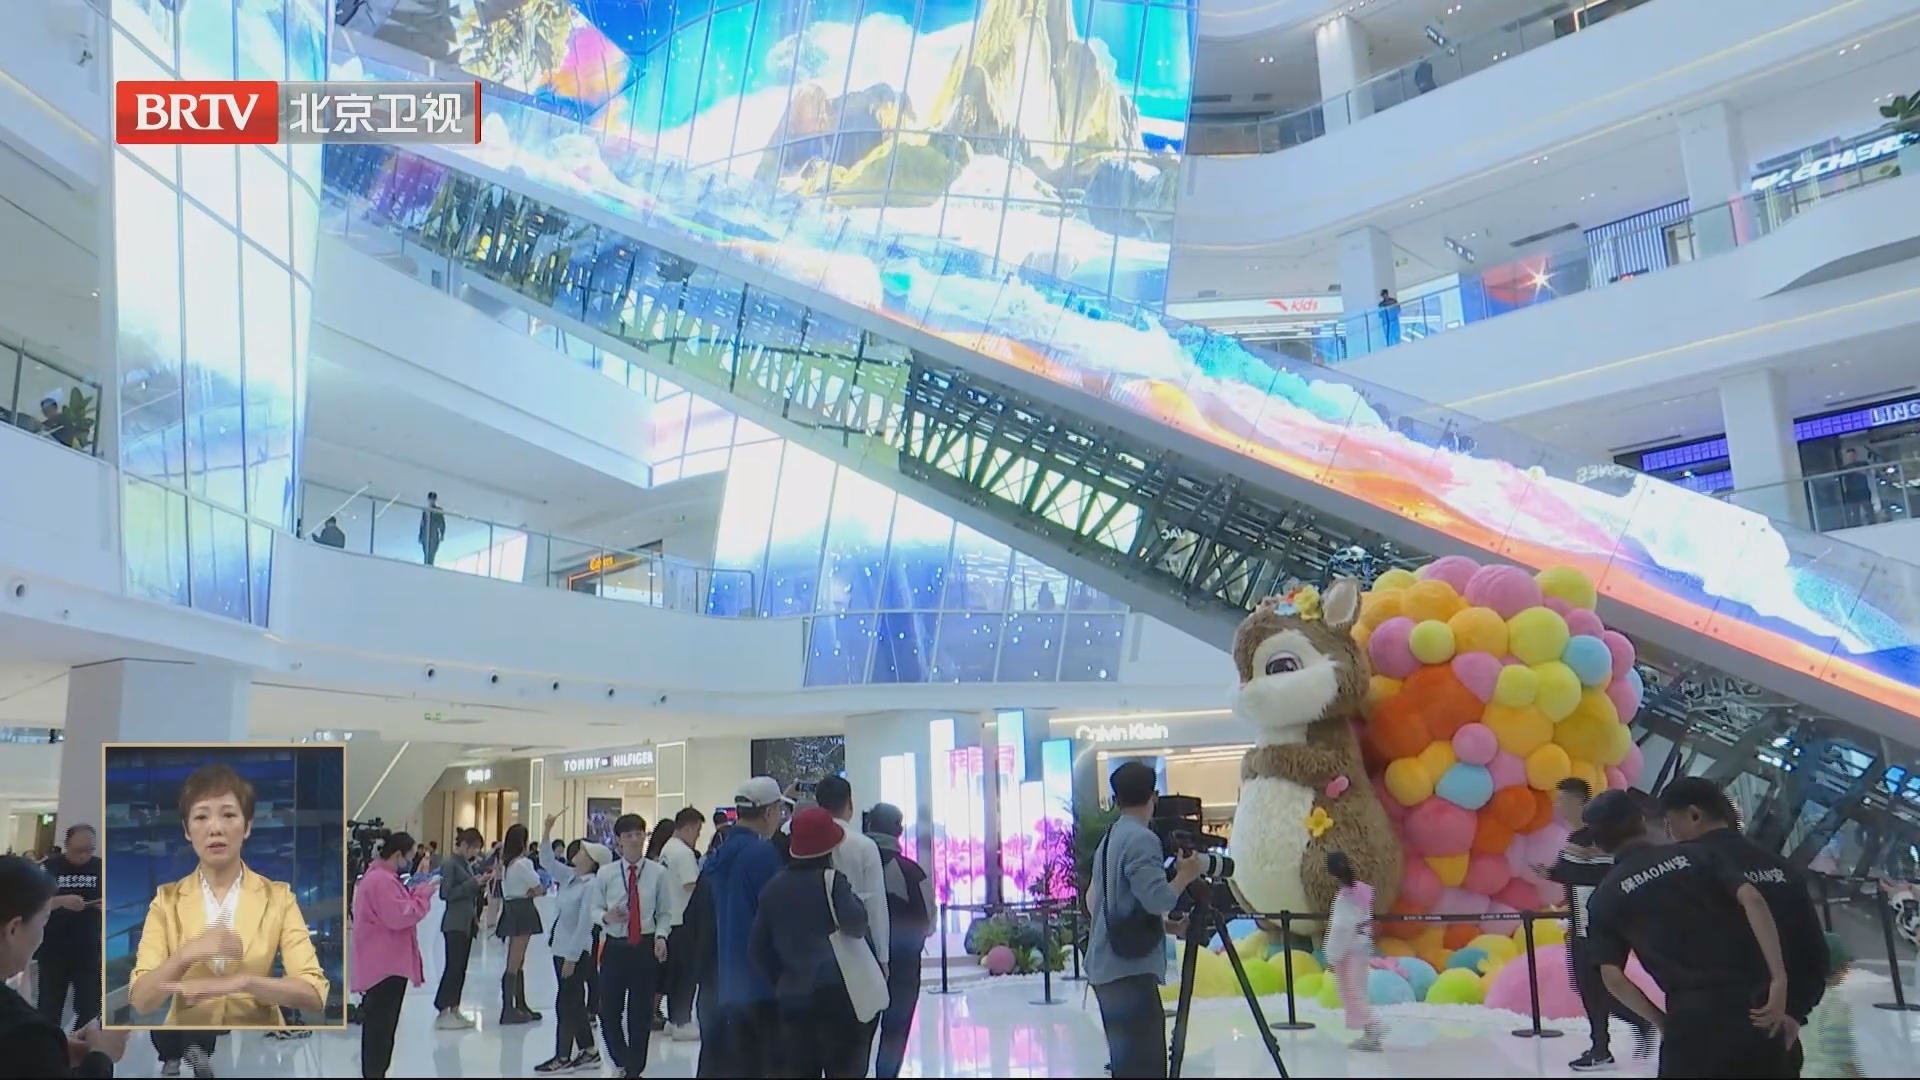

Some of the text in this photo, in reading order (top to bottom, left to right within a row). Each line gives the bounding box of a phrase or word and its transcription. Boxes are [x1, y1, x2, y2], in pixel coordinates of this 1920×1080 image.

[1128, 722, 1169, 740] Klein
[563, 751, 654, 772] TOMMY HILFIGER
[1620, 854, 1692, 894] 保BAOAN安
